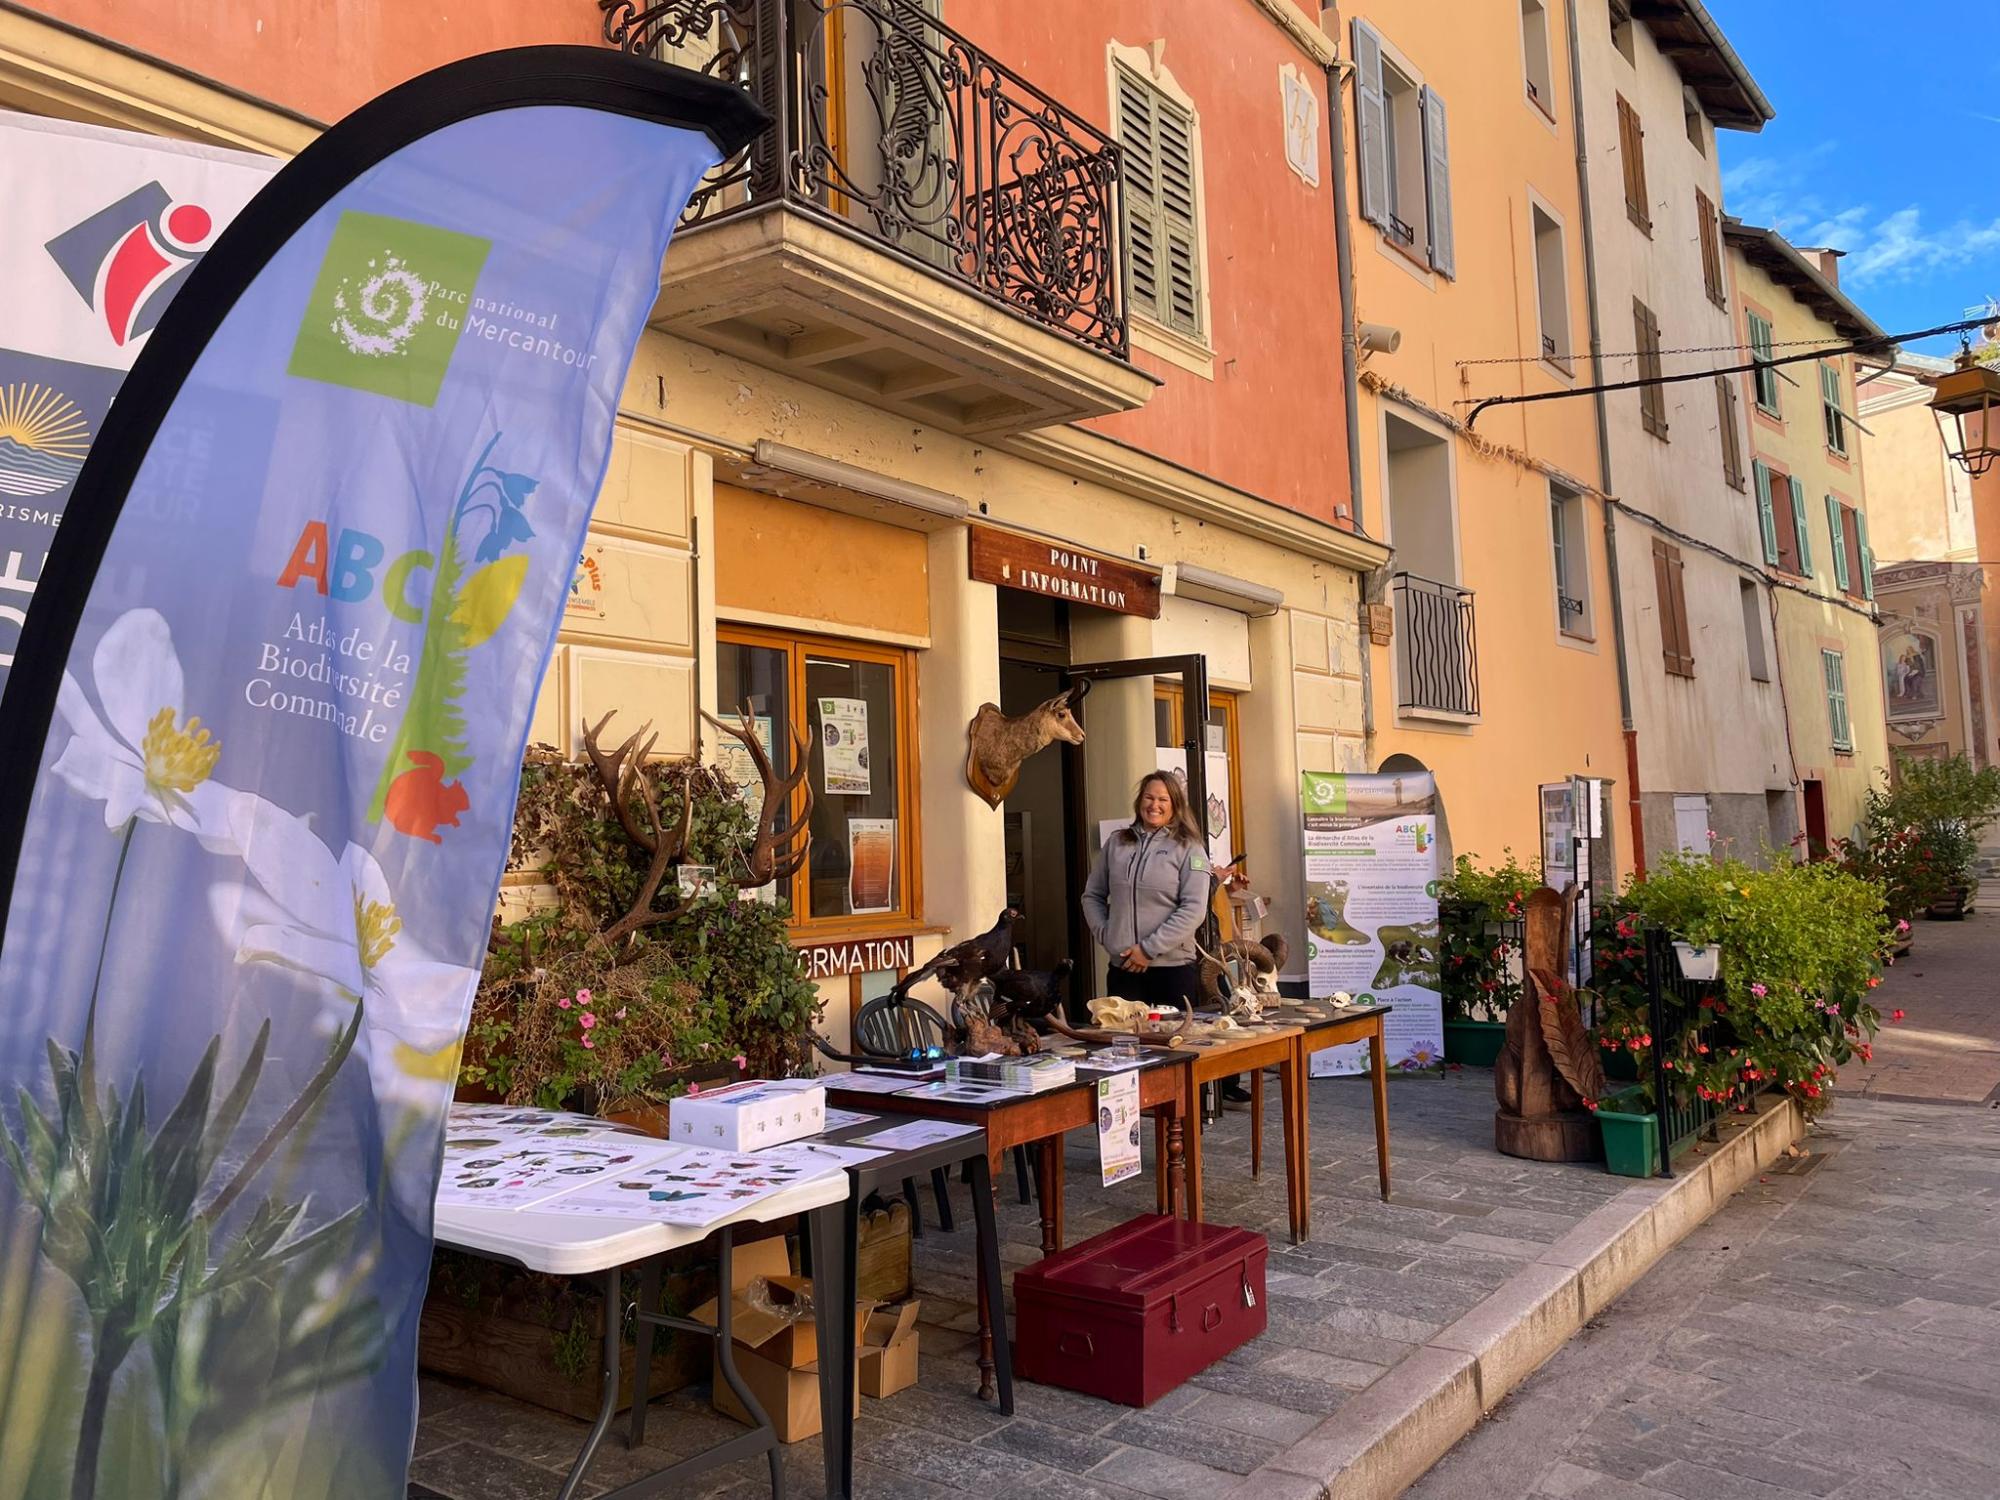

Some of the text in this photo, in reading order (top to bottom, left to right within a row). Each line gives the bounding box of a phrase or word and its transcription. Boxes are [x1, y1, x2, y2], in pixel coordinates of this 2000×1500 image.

[428, 281, 558, 330] Parc national
[436, 311, 598, 370] du Mercantour
[276, 519, 436, 624] ABC
[1050, 549, 1098, 576] POINT
[1021, 570, 1126, 609] INFORMATION
[282, 612, 411, 674] Atlas de la
[257, 642, 404, 708] Biodiversité
[1395, 825, 1416, 833] ABC
[1429, 884, 1436, 895] 1
[1308, 945, 1316, 957] 2
